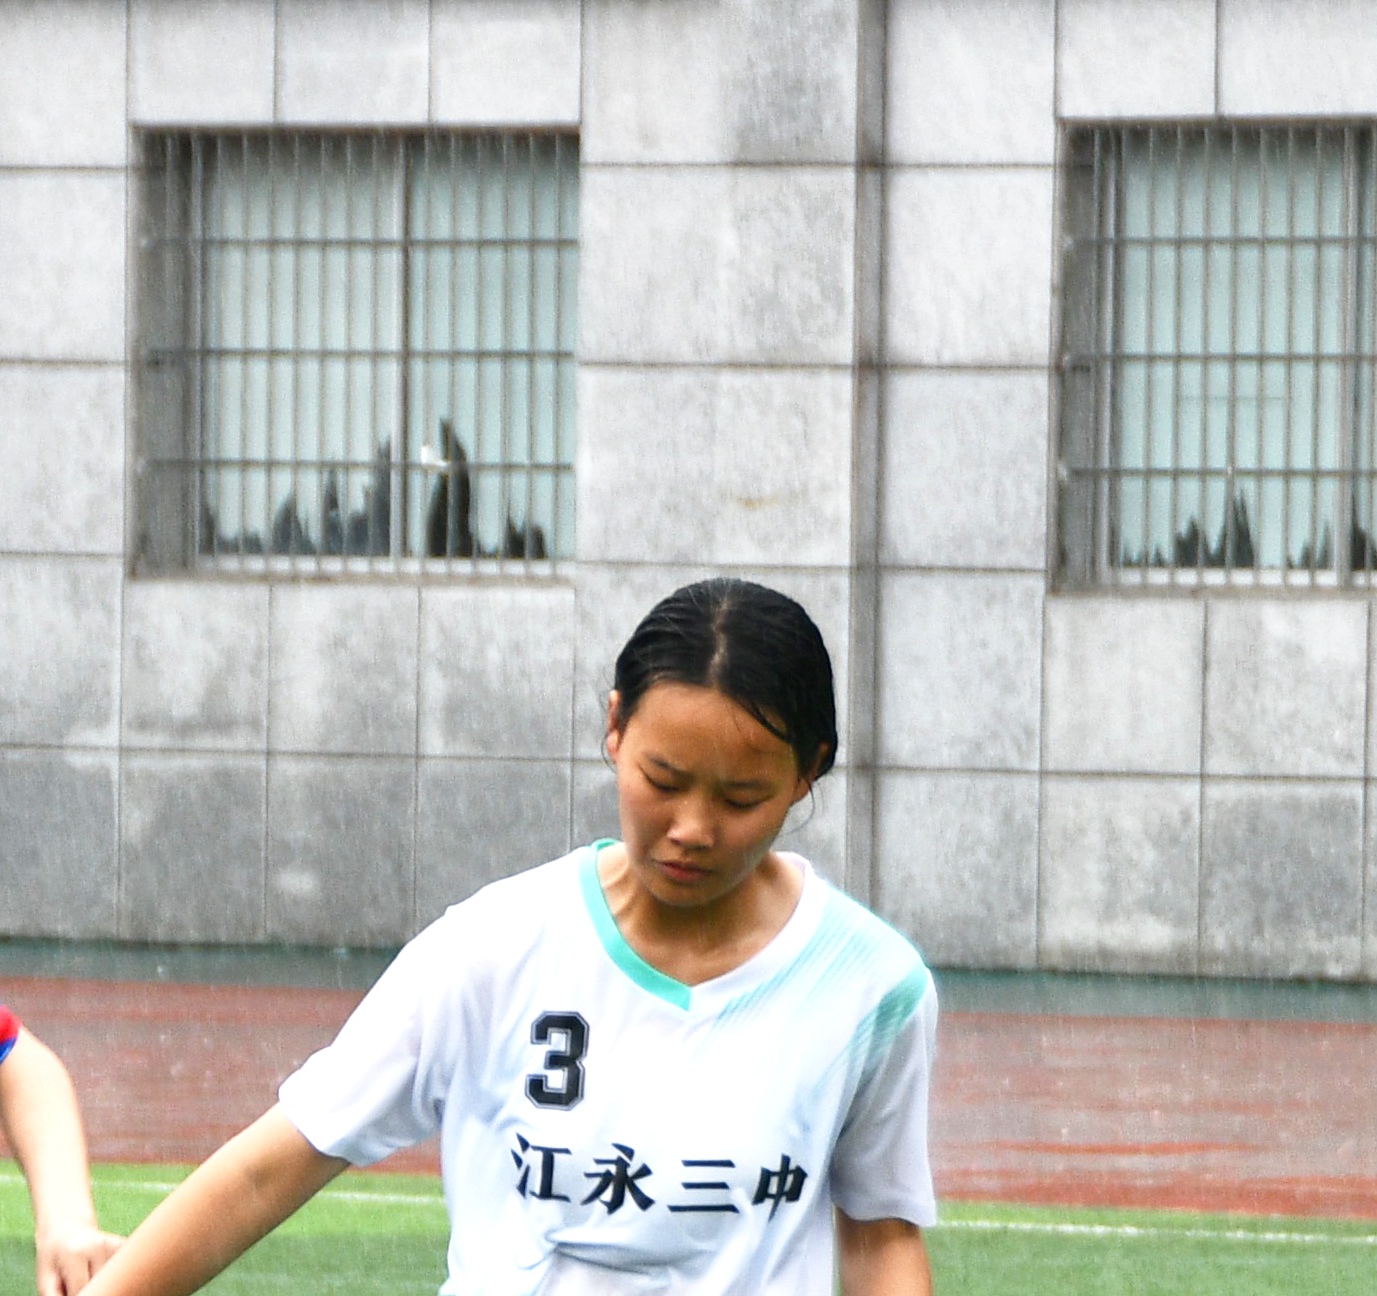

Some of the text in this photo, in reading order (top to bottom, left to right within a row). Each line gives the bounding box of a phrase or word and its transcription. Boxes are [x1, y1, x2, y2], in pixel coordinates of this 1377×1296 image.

[525, 1010, 590, 1111] 3
[511, 1132, 808, 1223] 江永三中
